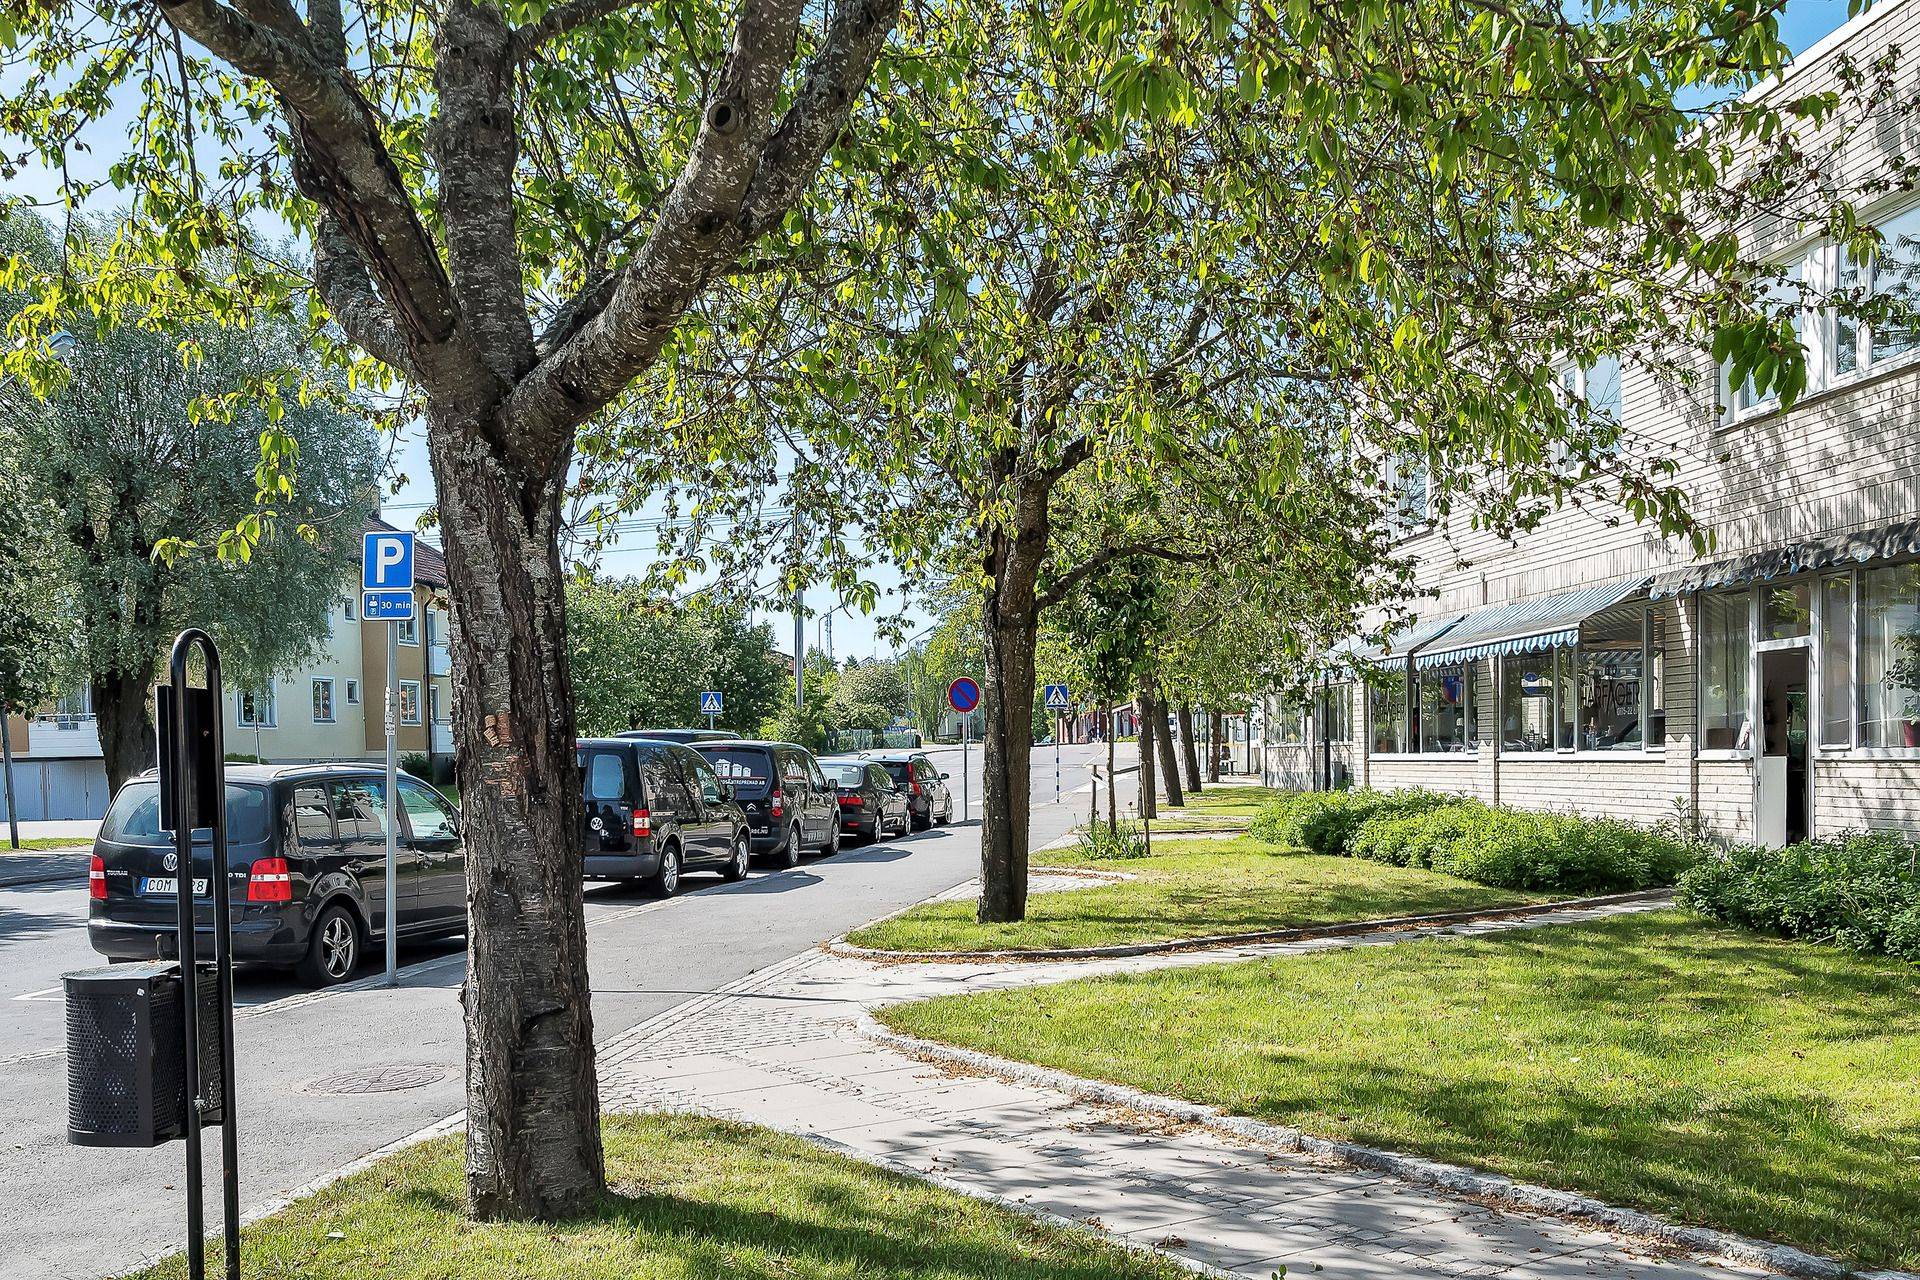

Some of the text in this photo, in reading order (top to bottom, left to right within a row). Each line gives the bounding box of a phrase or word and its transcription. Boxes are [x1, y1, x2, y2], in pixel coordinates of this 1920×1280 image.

[376, 538, 405, 584] P
[381, 600, 411, 610] 30 min
[148, 879, 172, 892] COM
